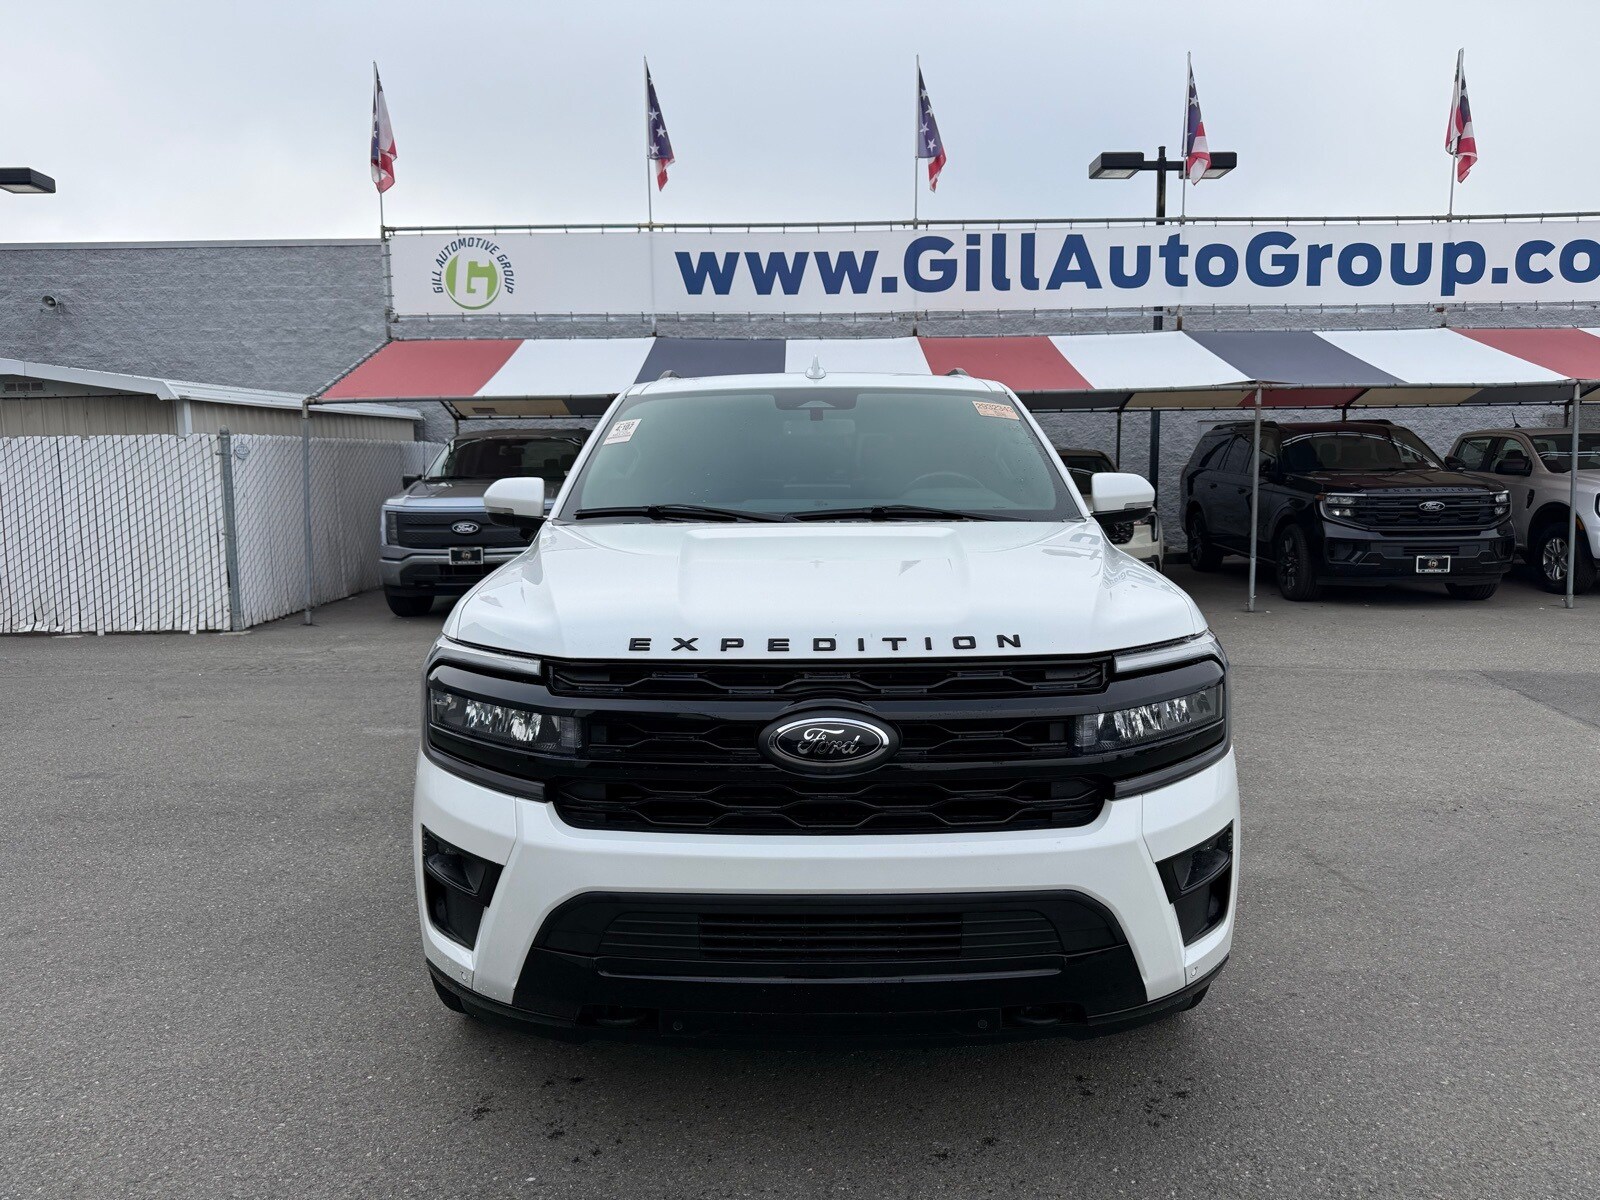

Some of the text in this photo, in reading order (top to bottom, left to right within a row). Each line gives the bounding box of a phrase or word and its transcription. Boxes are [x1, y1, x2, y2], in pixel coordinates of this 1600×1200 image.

[432, 237, 515, 294] GILL AUTOMOTIVE GROUP
[628, 634, 1022, 652] EXPEDITION
[797, 727, 861, 755] Ford
